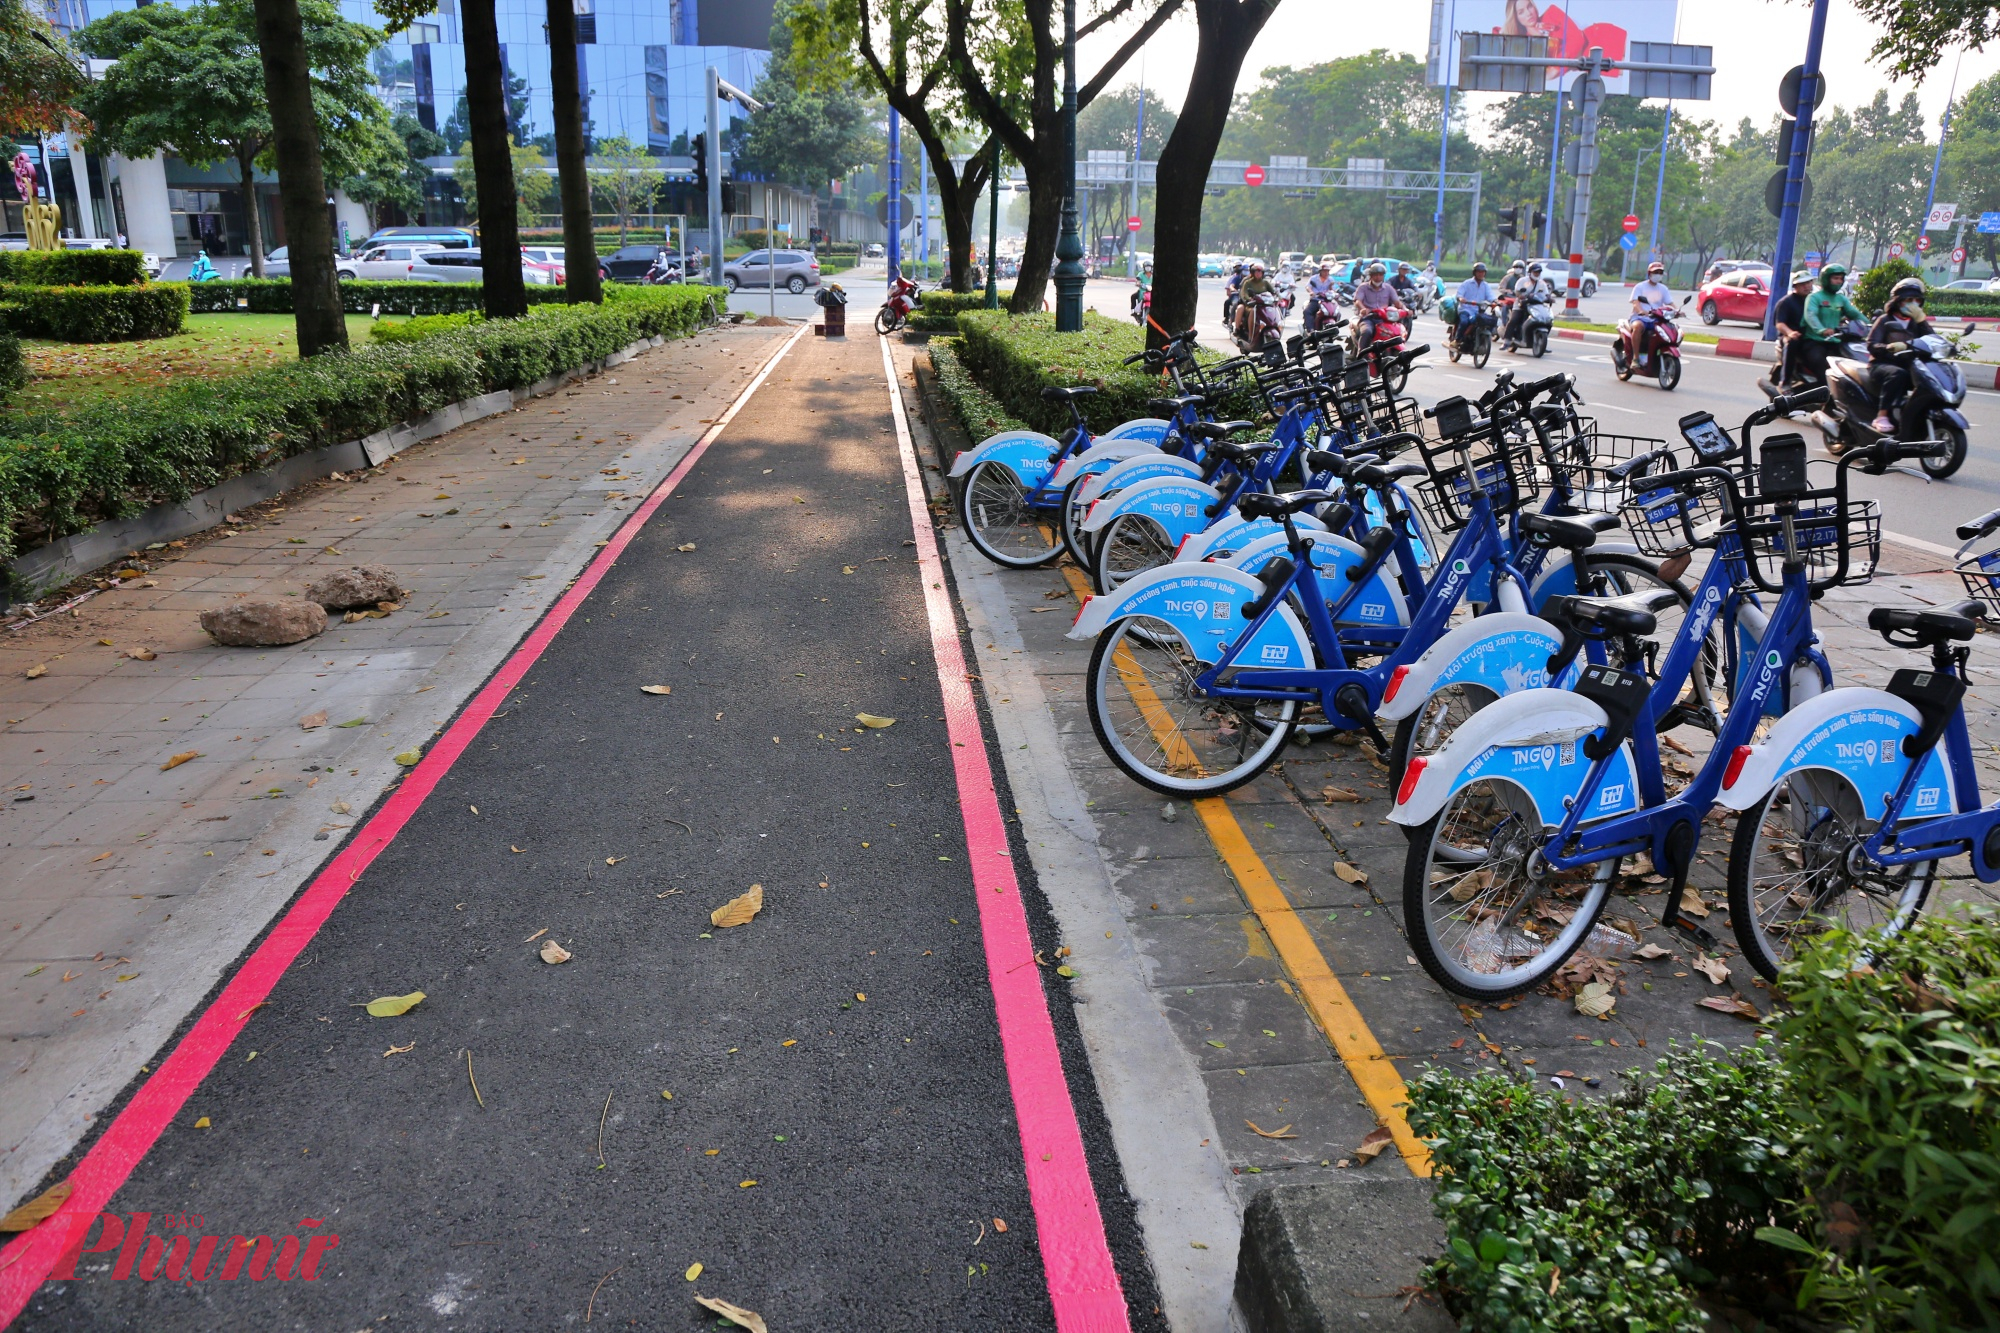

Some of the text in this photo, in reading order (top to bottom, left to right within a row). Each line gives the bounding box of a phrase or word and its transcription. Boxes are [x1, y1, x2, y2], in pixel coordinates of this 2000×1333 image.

[1011, 439, 1026, 448] xanh
[1437, 558, 1471, 600] TNGO
[1122, 578, 1236, 613] Môi trường xanh. Cuộc sống khỏe
[1164, 599, 1208, 620] TNGO
[1263, 646, 1287, 659] TN
[1445, 662, 1463, 681] Môi
[1461, 641, 1495, 664] trường
[1495, 633, 1517, 647] xanh
[1524, 633, 1545, 648] Cuộc
[1544, 639, 1558, 654] sốn
[1751, 650, 1783, 701] TNGO
[1790, 749, 1807, 766] Môi
[1806, 727, 1830, 752] trường
[1830, 718, 1850, 734] xanh.
[1867, 710, 1885, 724] sống
[1884, 714, 1901, 731] khỏe
[1512, 744, 1556, 772] TNGO
[1835, 739, 1877, 767] TNGO
[1466, 759, 1482, 777] Môi
